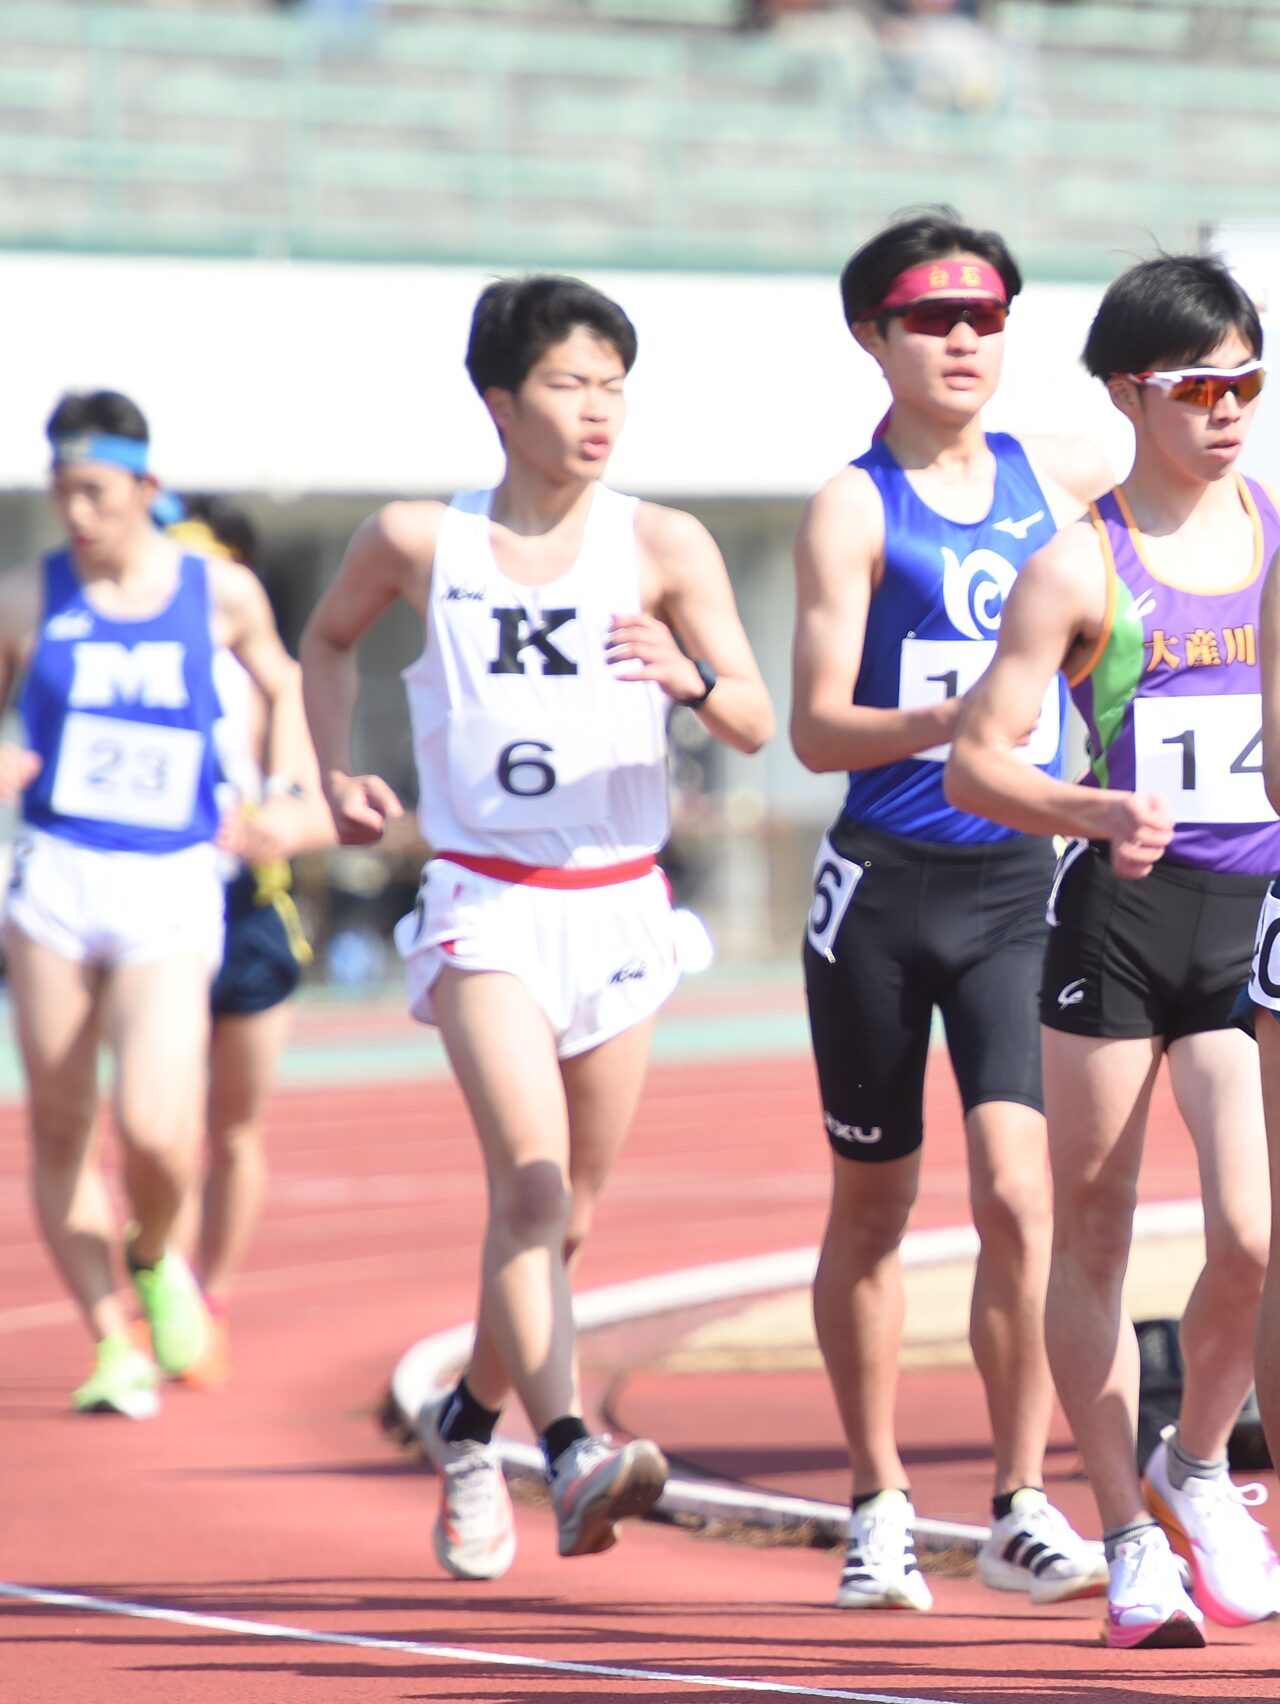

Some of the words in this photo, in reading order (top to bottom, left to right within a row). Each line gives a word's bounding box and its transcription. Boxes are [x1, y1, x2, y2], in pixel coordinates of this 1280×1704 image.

[488, 607, 578, 675] K
[69, 641, 190, 709] M
[84, 738, 172, 801] 23
[496, 740, 557, 797] 6
